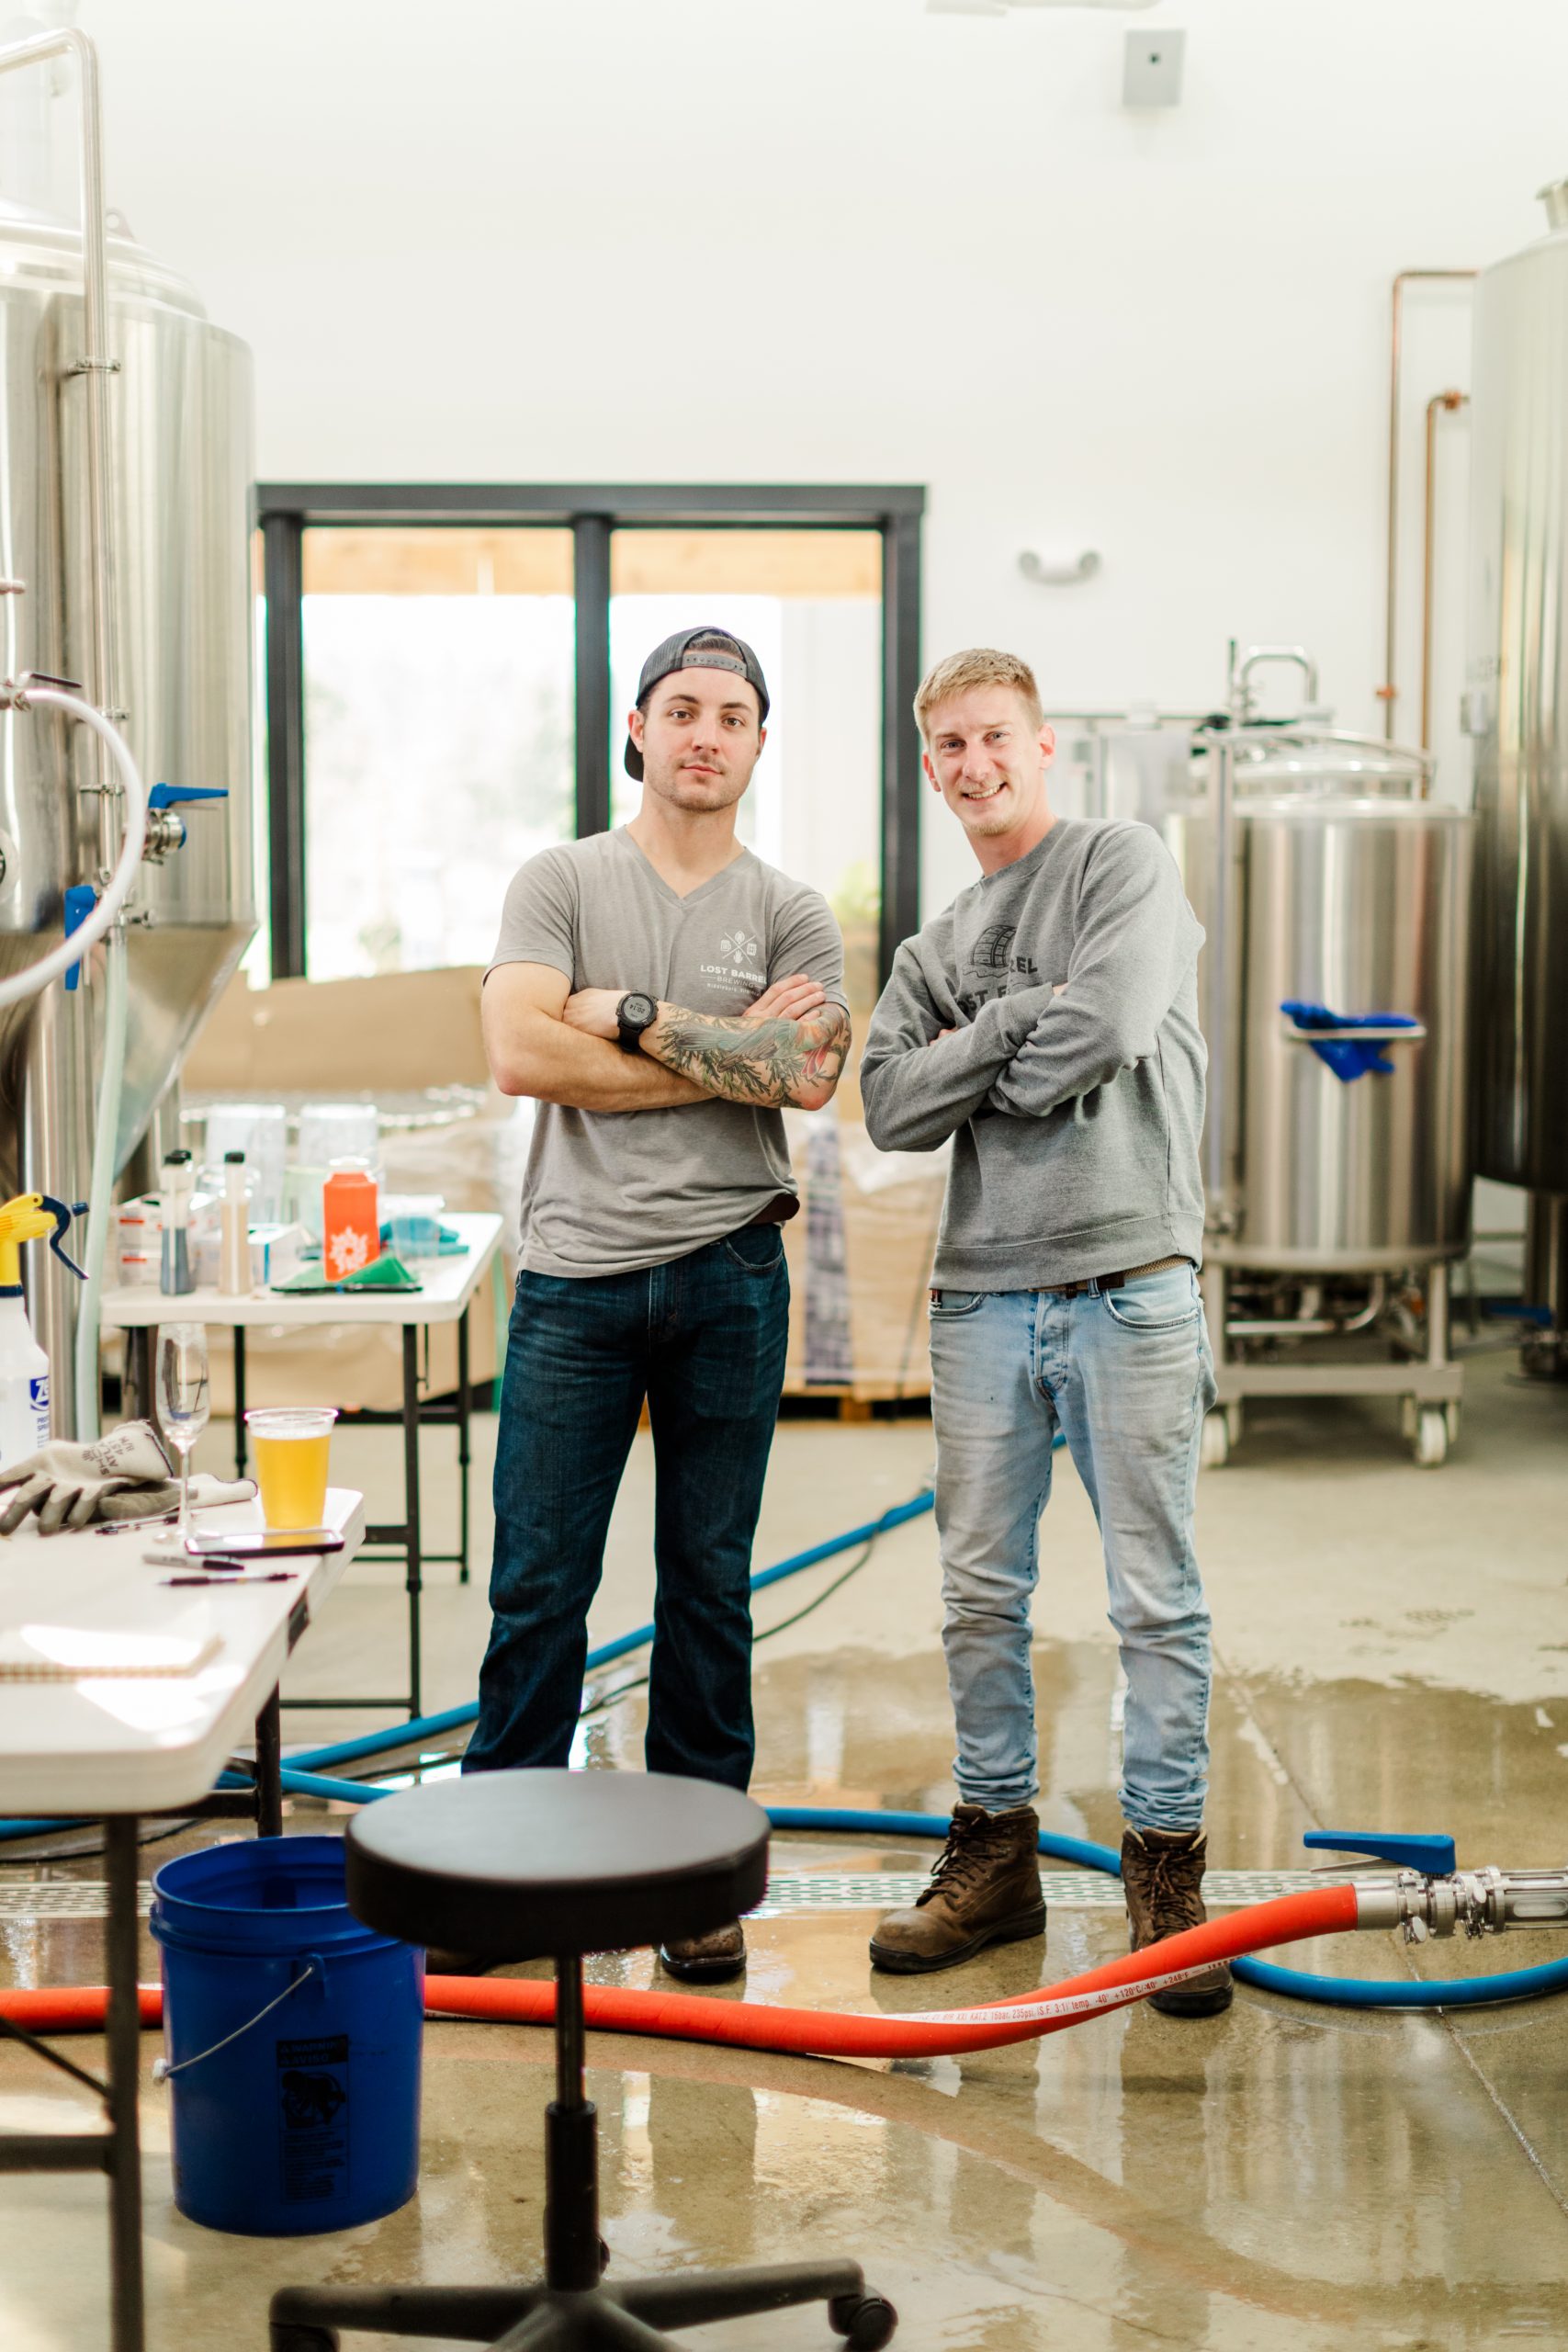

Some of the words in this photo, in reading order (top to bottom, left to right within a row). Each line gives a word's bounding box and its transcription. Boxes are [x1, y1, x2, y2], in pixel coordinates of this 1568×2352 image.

[700, 965, 728, 975] LOST
[731, 969, 767, 984] BARREL
[716, 976, 754, 989] BREWING
